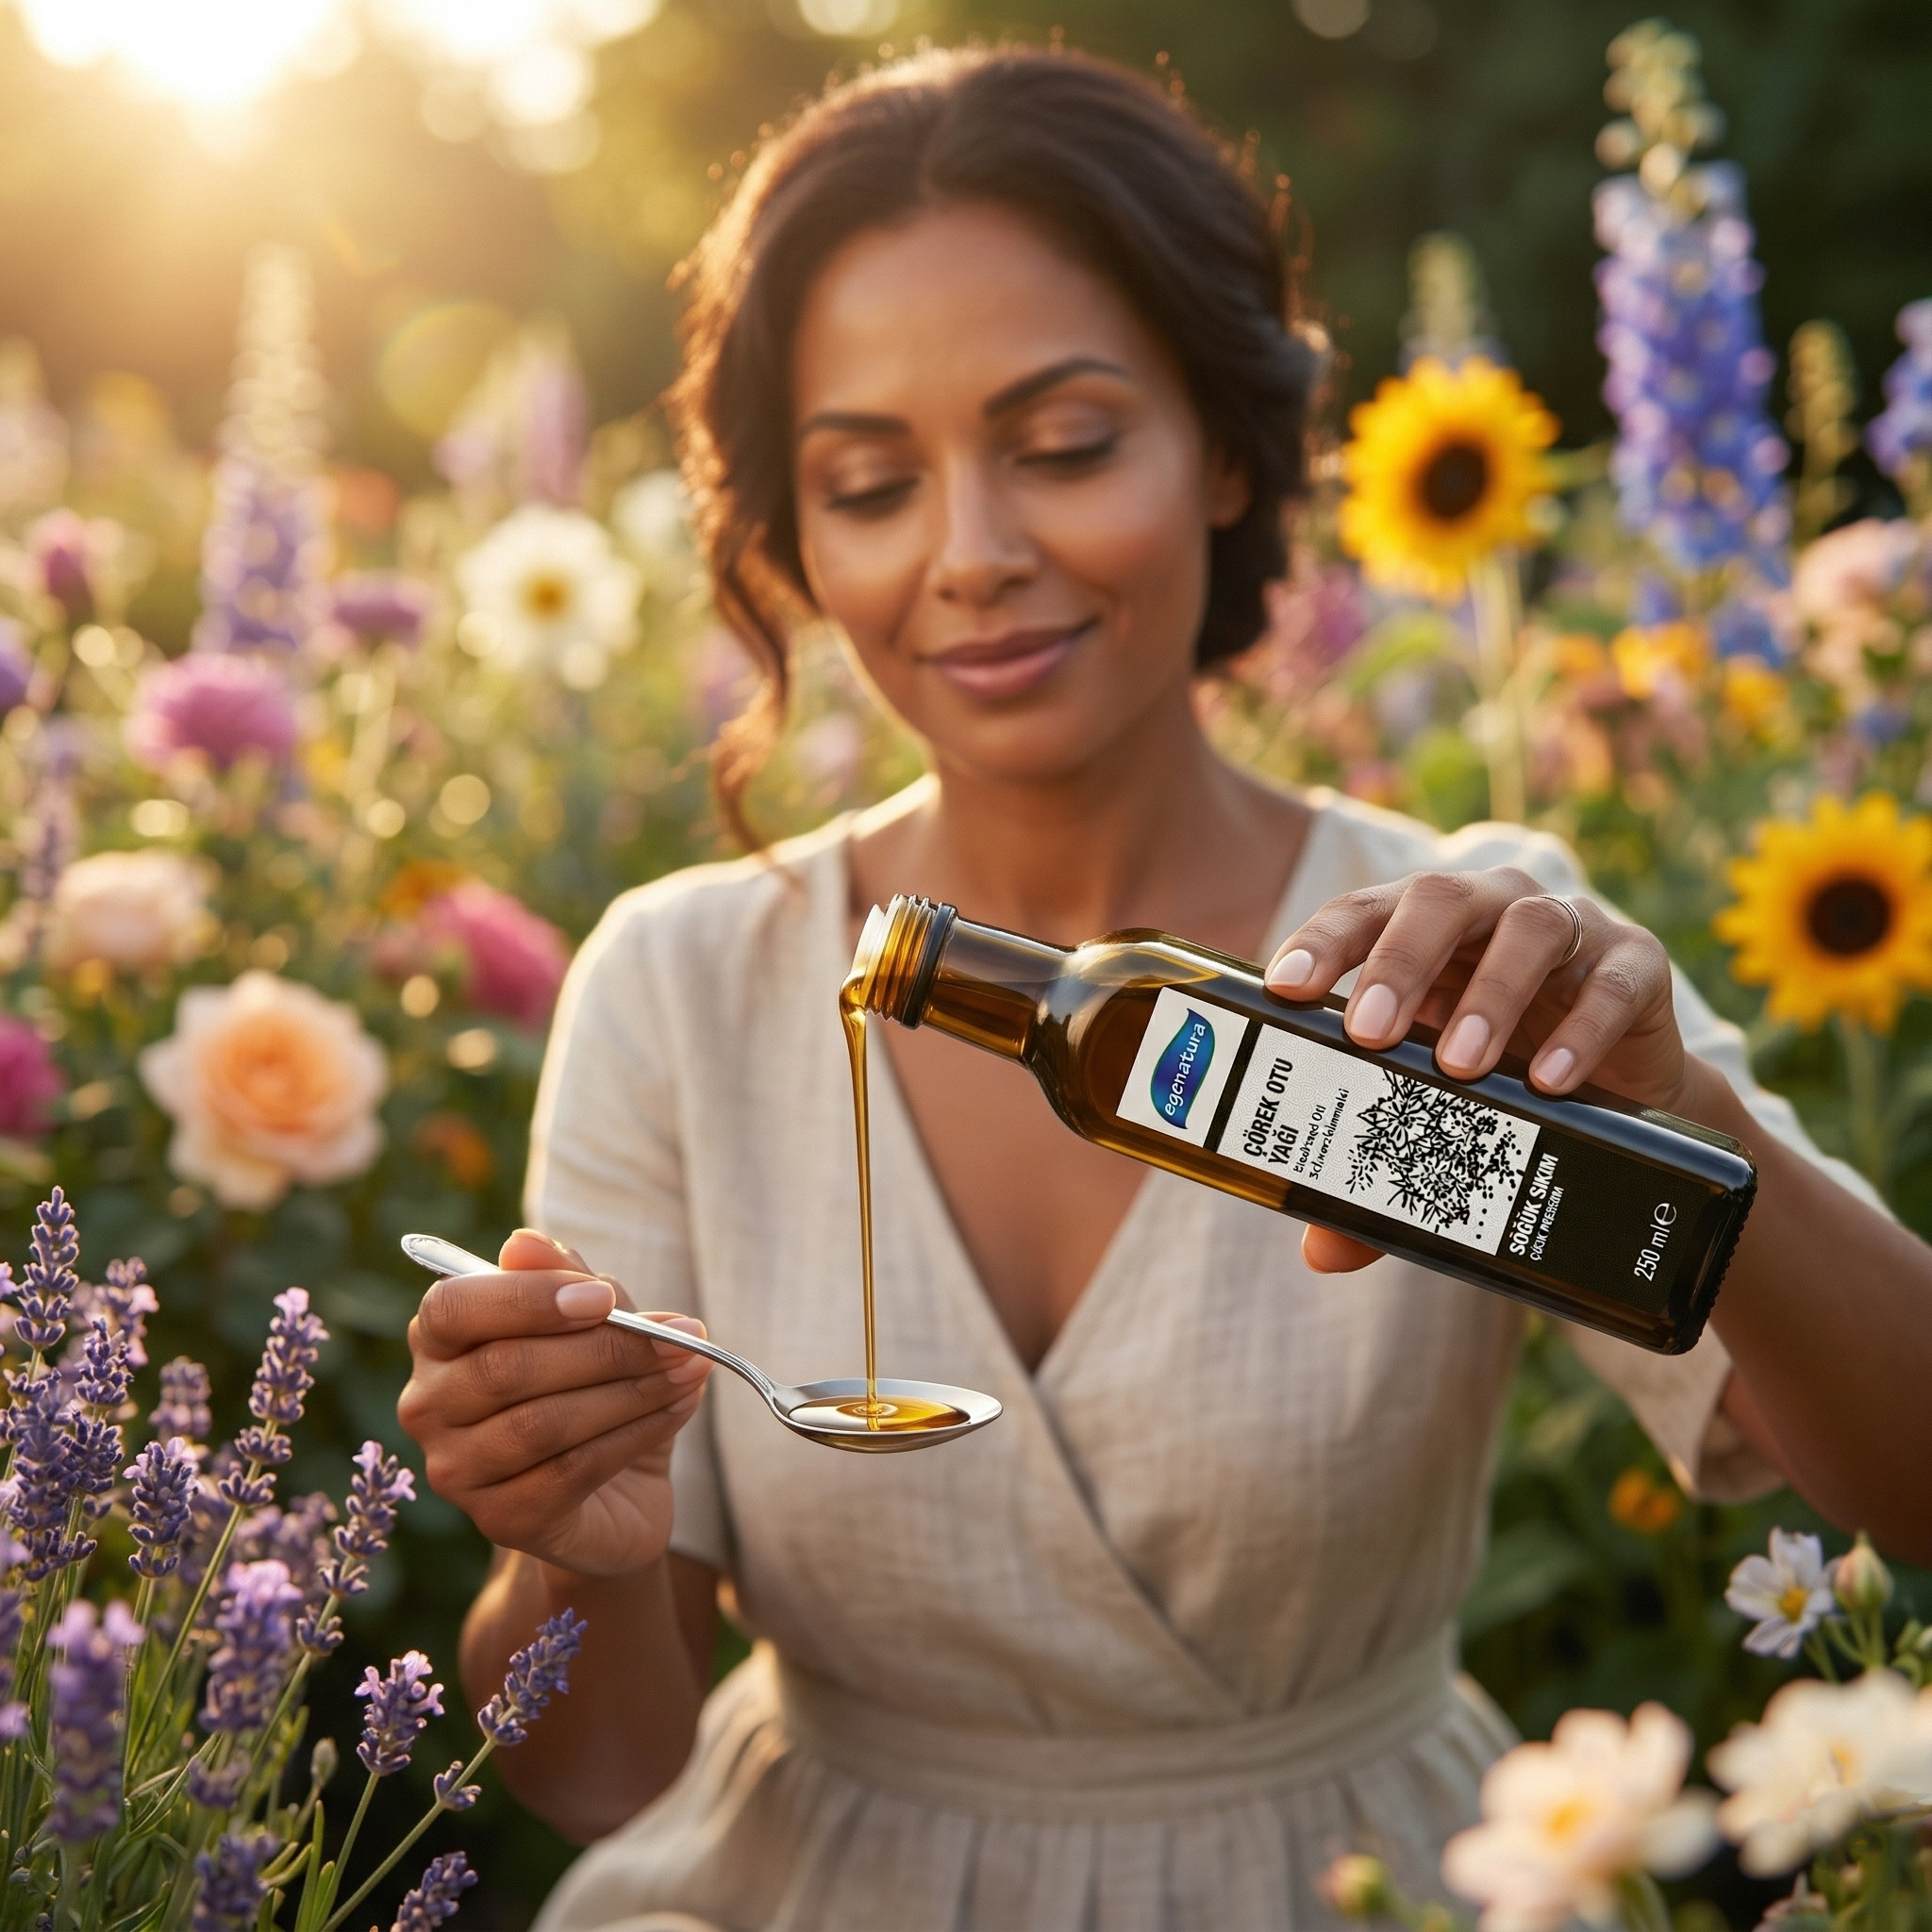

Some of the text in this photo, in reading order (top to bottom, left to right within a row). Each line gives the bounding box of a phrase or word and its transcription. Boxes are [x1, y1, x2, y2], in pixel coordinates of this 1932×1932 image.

[1164, 1023, 1207, 1117] egenatura
[1242, 1058, 1293, 1158] ÇÖREK OTU
[1268, 1124, 1299, 1165] YAĞI
[1529, 1153, 1559, 1200] SIKIM
[1633, 1248, 1661, 1282] 250
